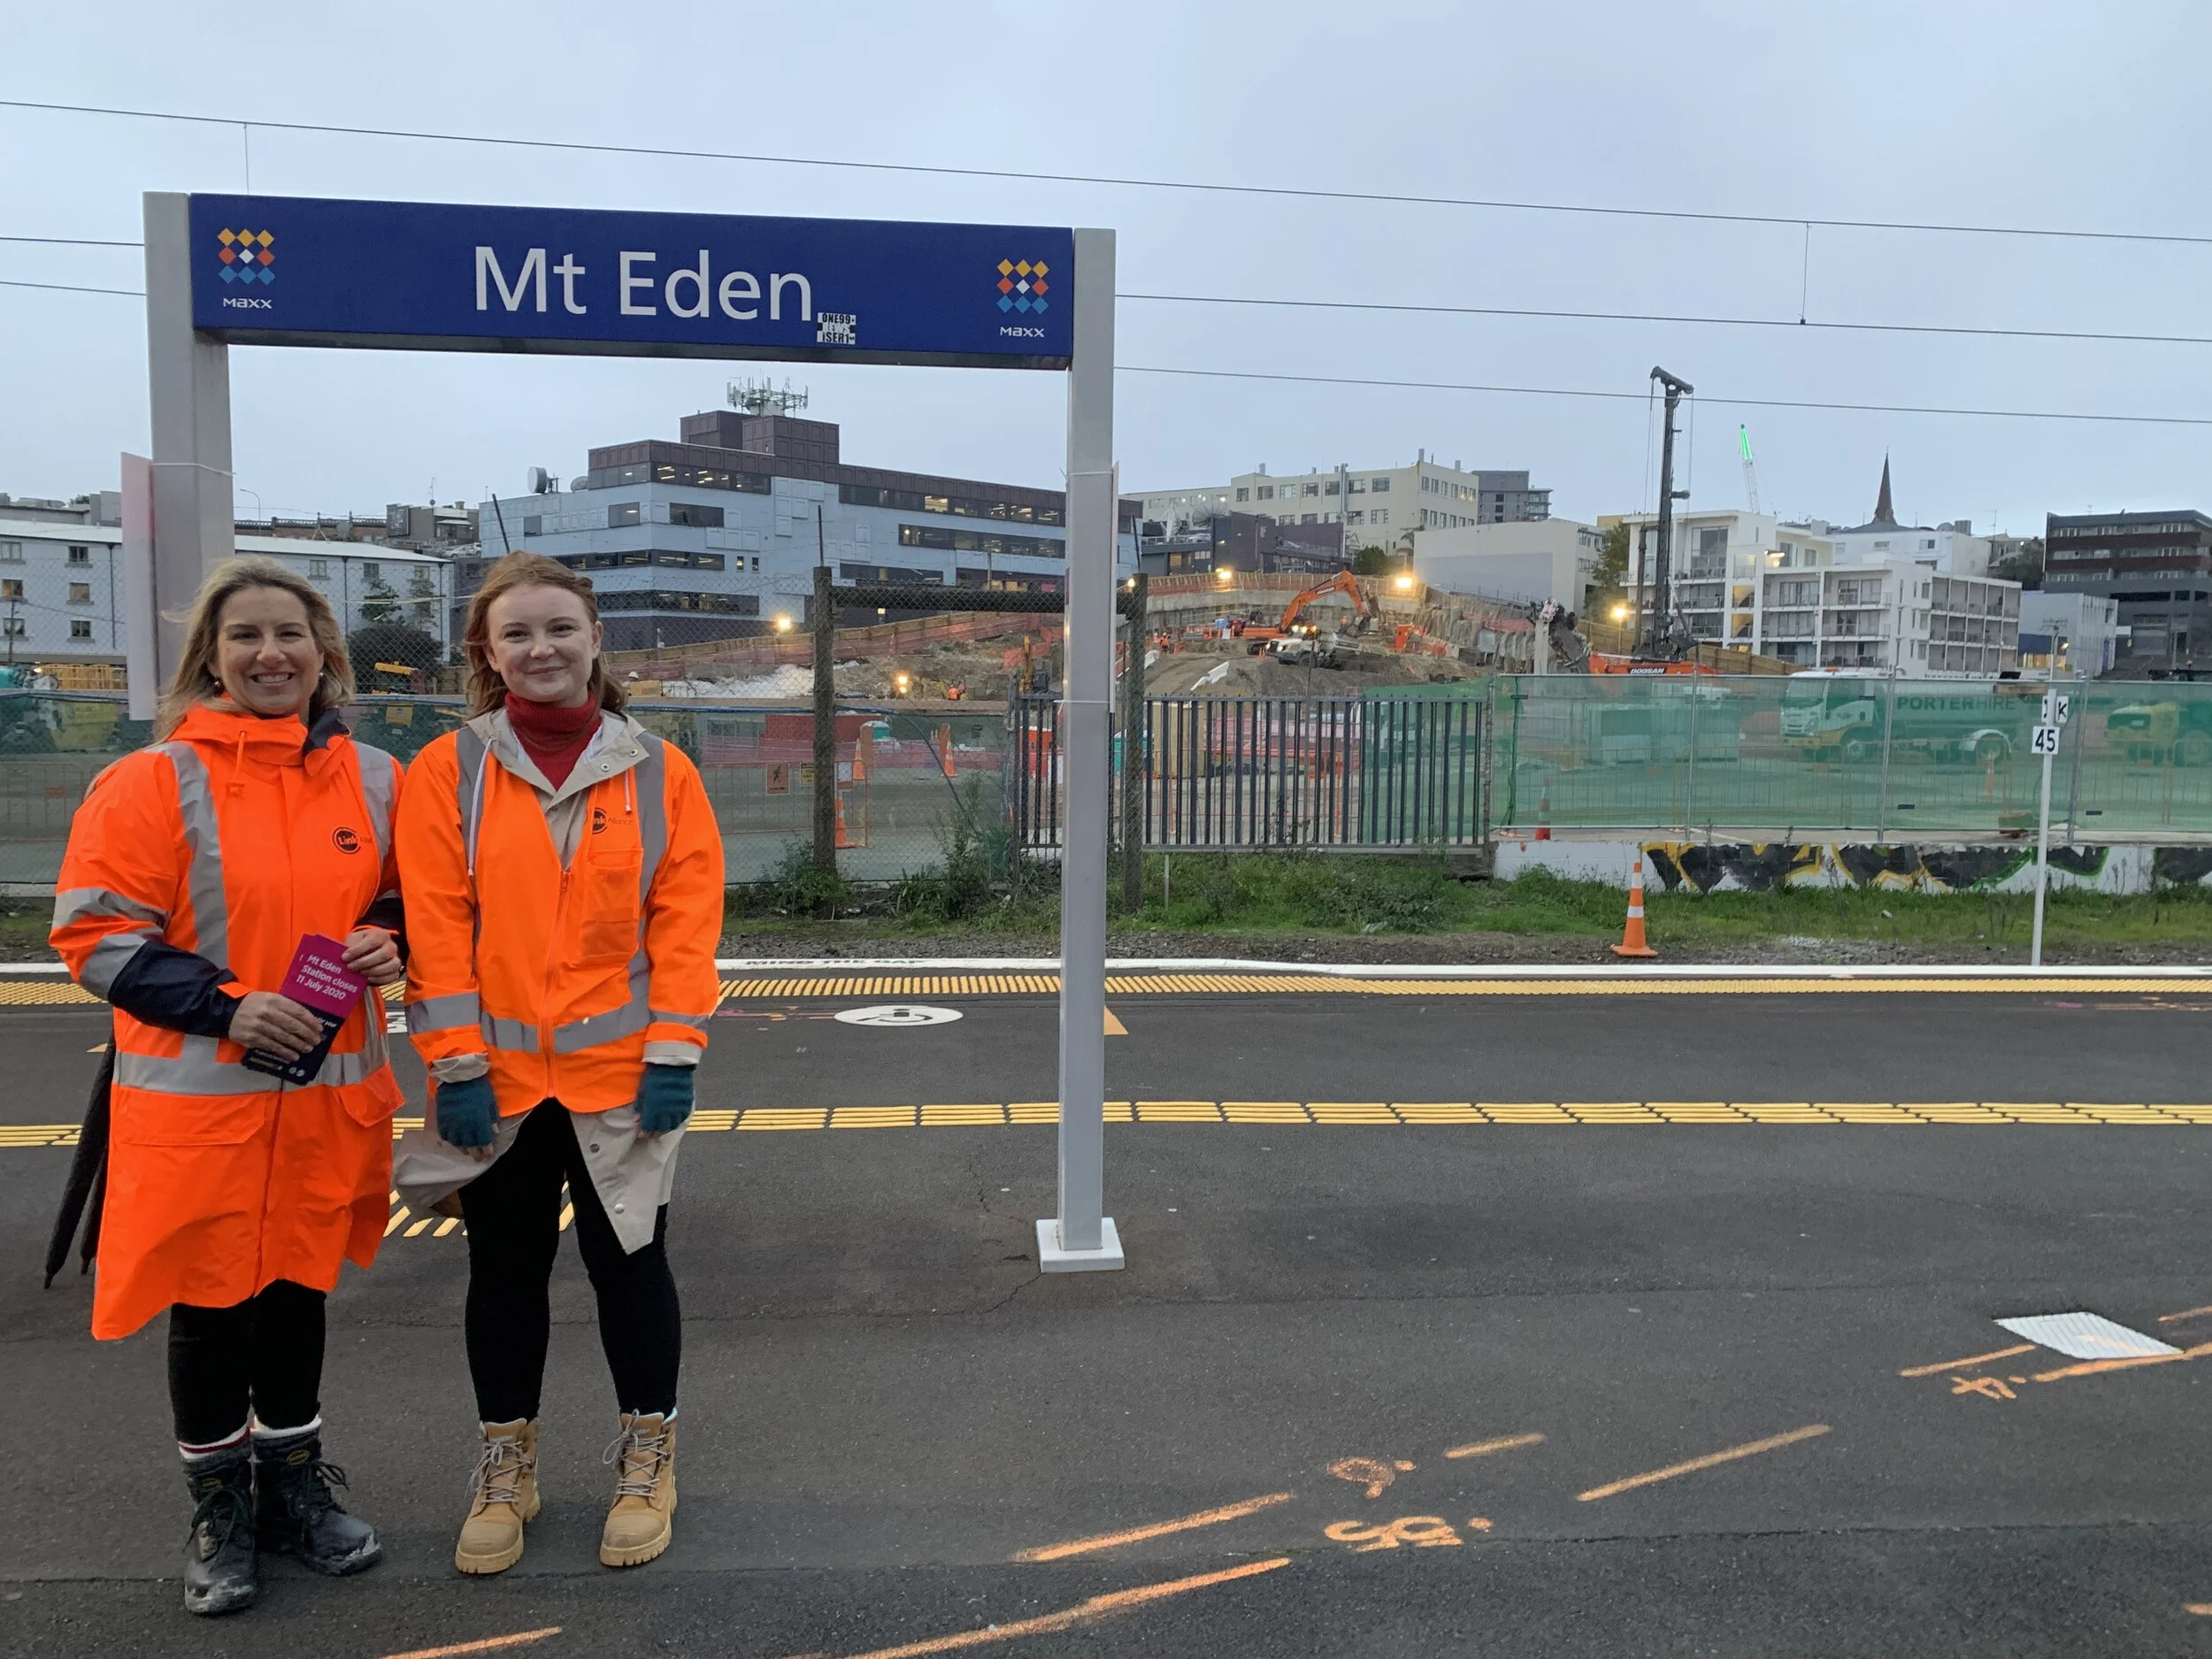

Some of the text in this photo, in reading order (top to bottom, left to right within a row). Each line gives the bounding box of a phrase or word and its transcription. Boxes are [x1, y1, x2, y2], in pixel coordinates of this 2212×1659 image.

[474, 246, 811, 321] Mt Eden
[2035, 728, 2056, 752] 45
[306, 954, 342, 974] Mt Eden
[296, 974, 347, 1000] 11 July 2020
[301, 964, 358, 994] Station closes
